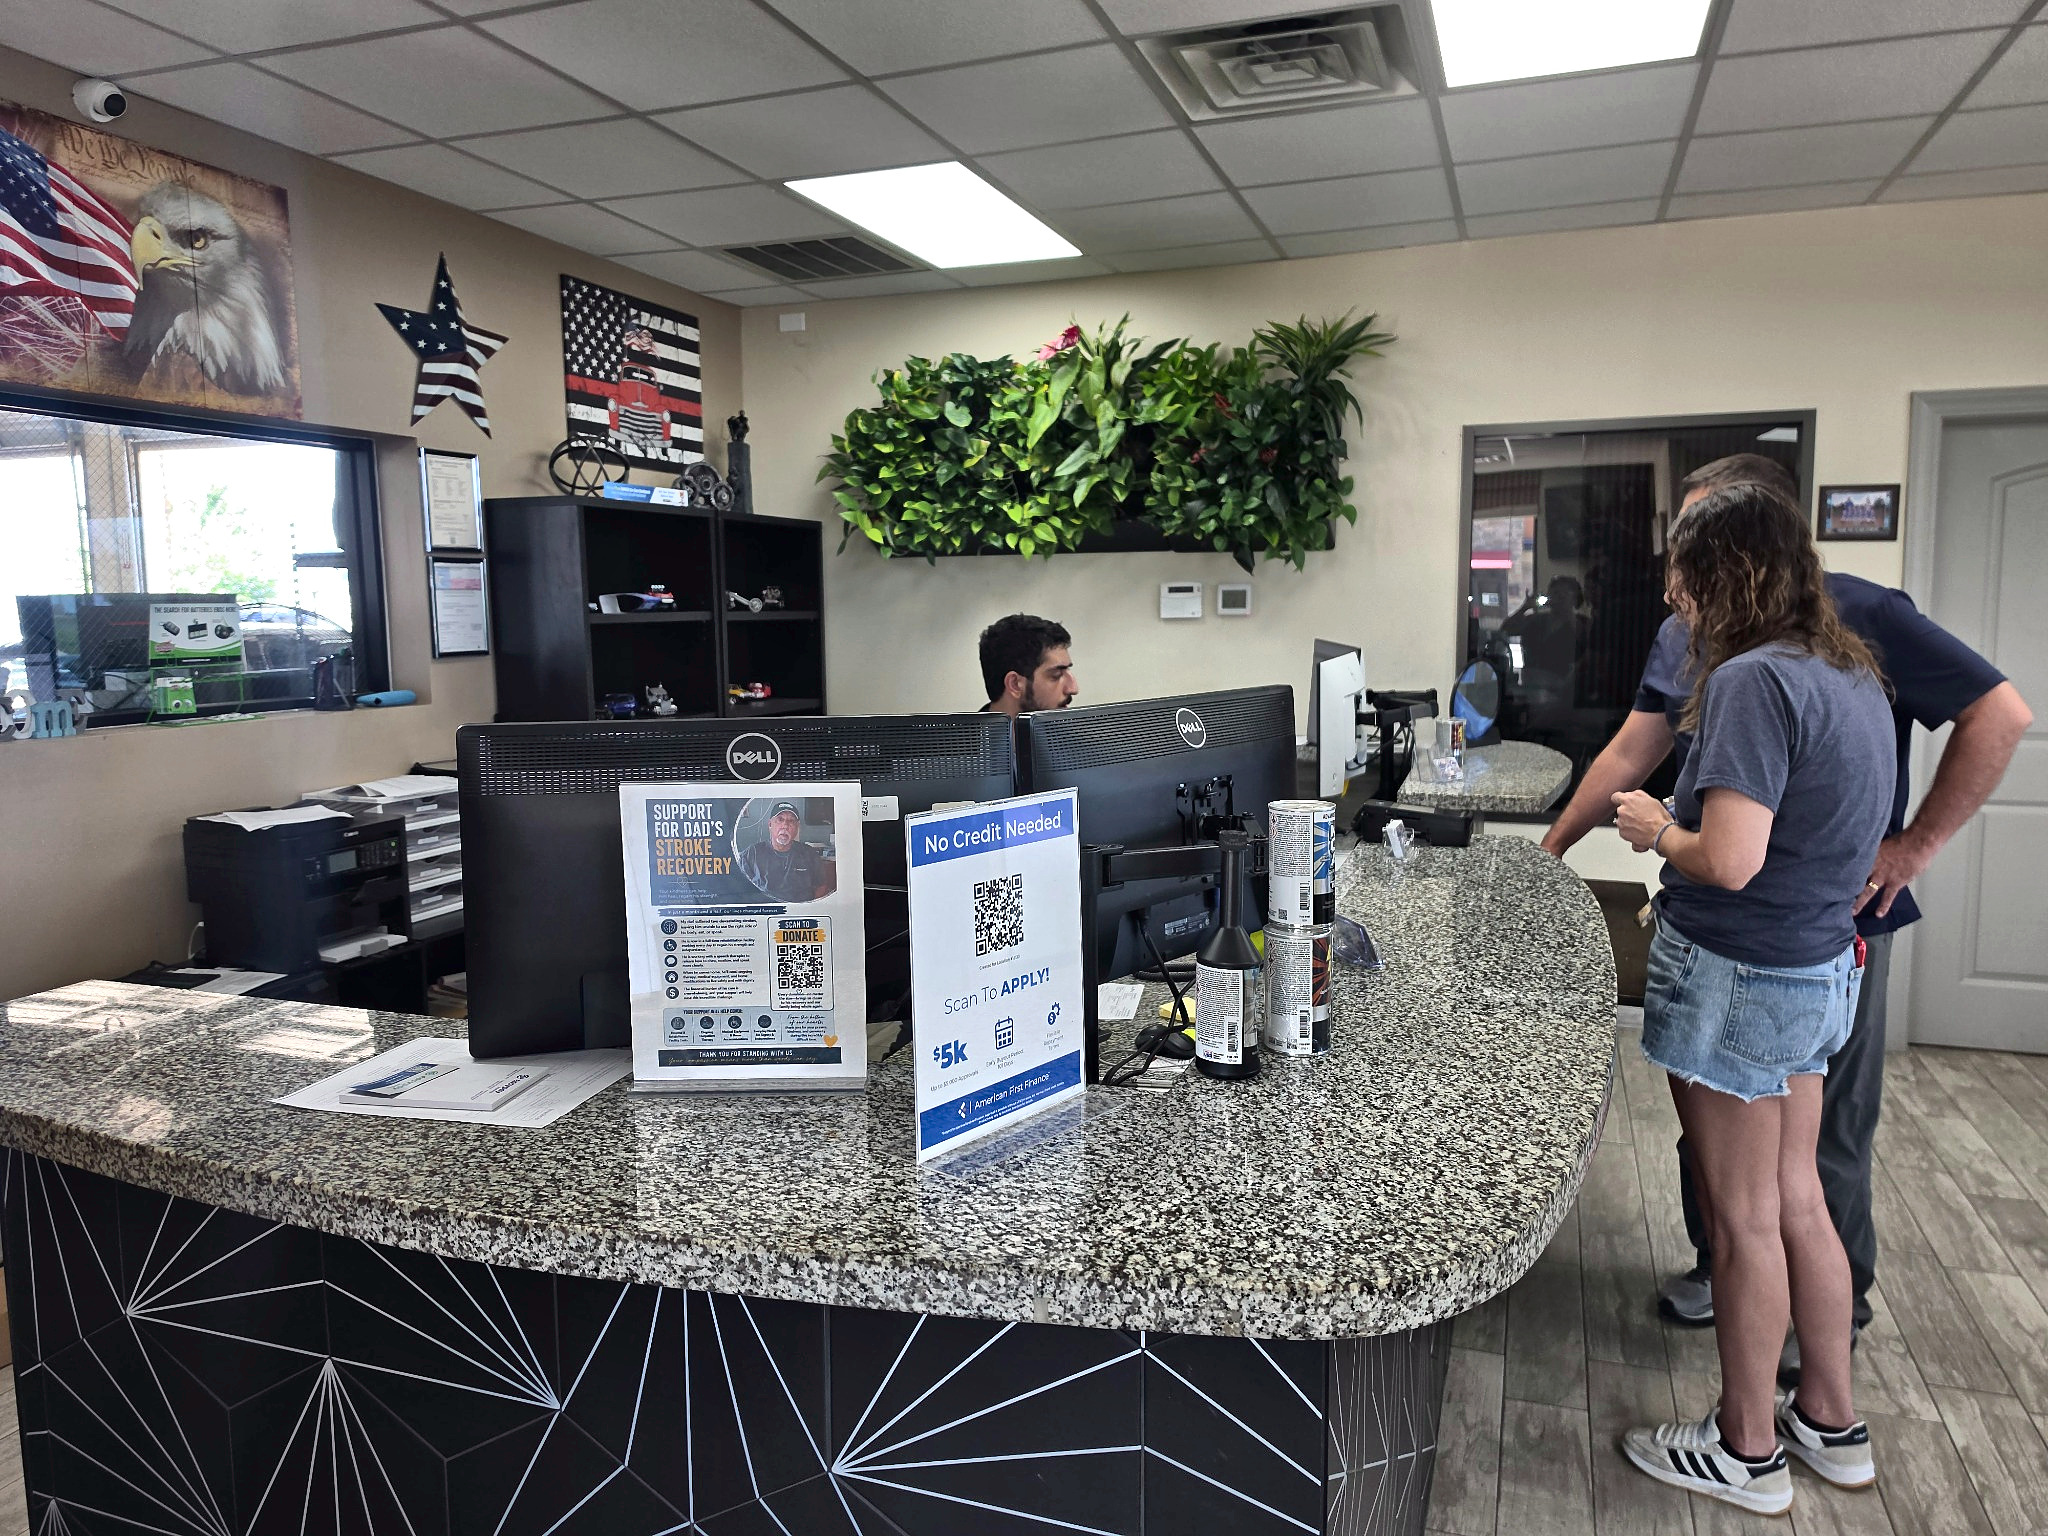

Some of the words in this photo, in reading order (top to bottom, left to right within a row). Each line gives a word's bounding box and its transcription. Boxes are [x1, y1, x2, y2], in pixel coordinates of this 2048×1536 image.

[62, 125, 94, 159] We
[98, 138, 130, 169] the
[1180, 722, 1202, 733] DELL
[733, 751, 775, 764] DELL
[654, 804, 712, 820] SUPPORT
[655, 822, 679, 837] FOR
[684, 821, 724, 837] DAD'S
[925, 835, 948, 854] No
[953, 823, 1002, 848] Credit
[1006, 810, 1062, 838] Needed
[656, 839, 712, 856] STROKE
[657, 857, 731, 875] RECOVERY
[802, 920, 809, 928] TO
[783, 931, 818, 942] DONATE
[944, 994, 978, 1014] Scan
[981, 986, 998, 1001] To
[1001, 967, 1050, 997] APPLY!
[934, 1040, 968, 1068] $5k
[974, 1090, 1008, 1110] American
[1009, 1081, 1024, 1096] First
[1024, 1072, 1050, 1089] Finance
